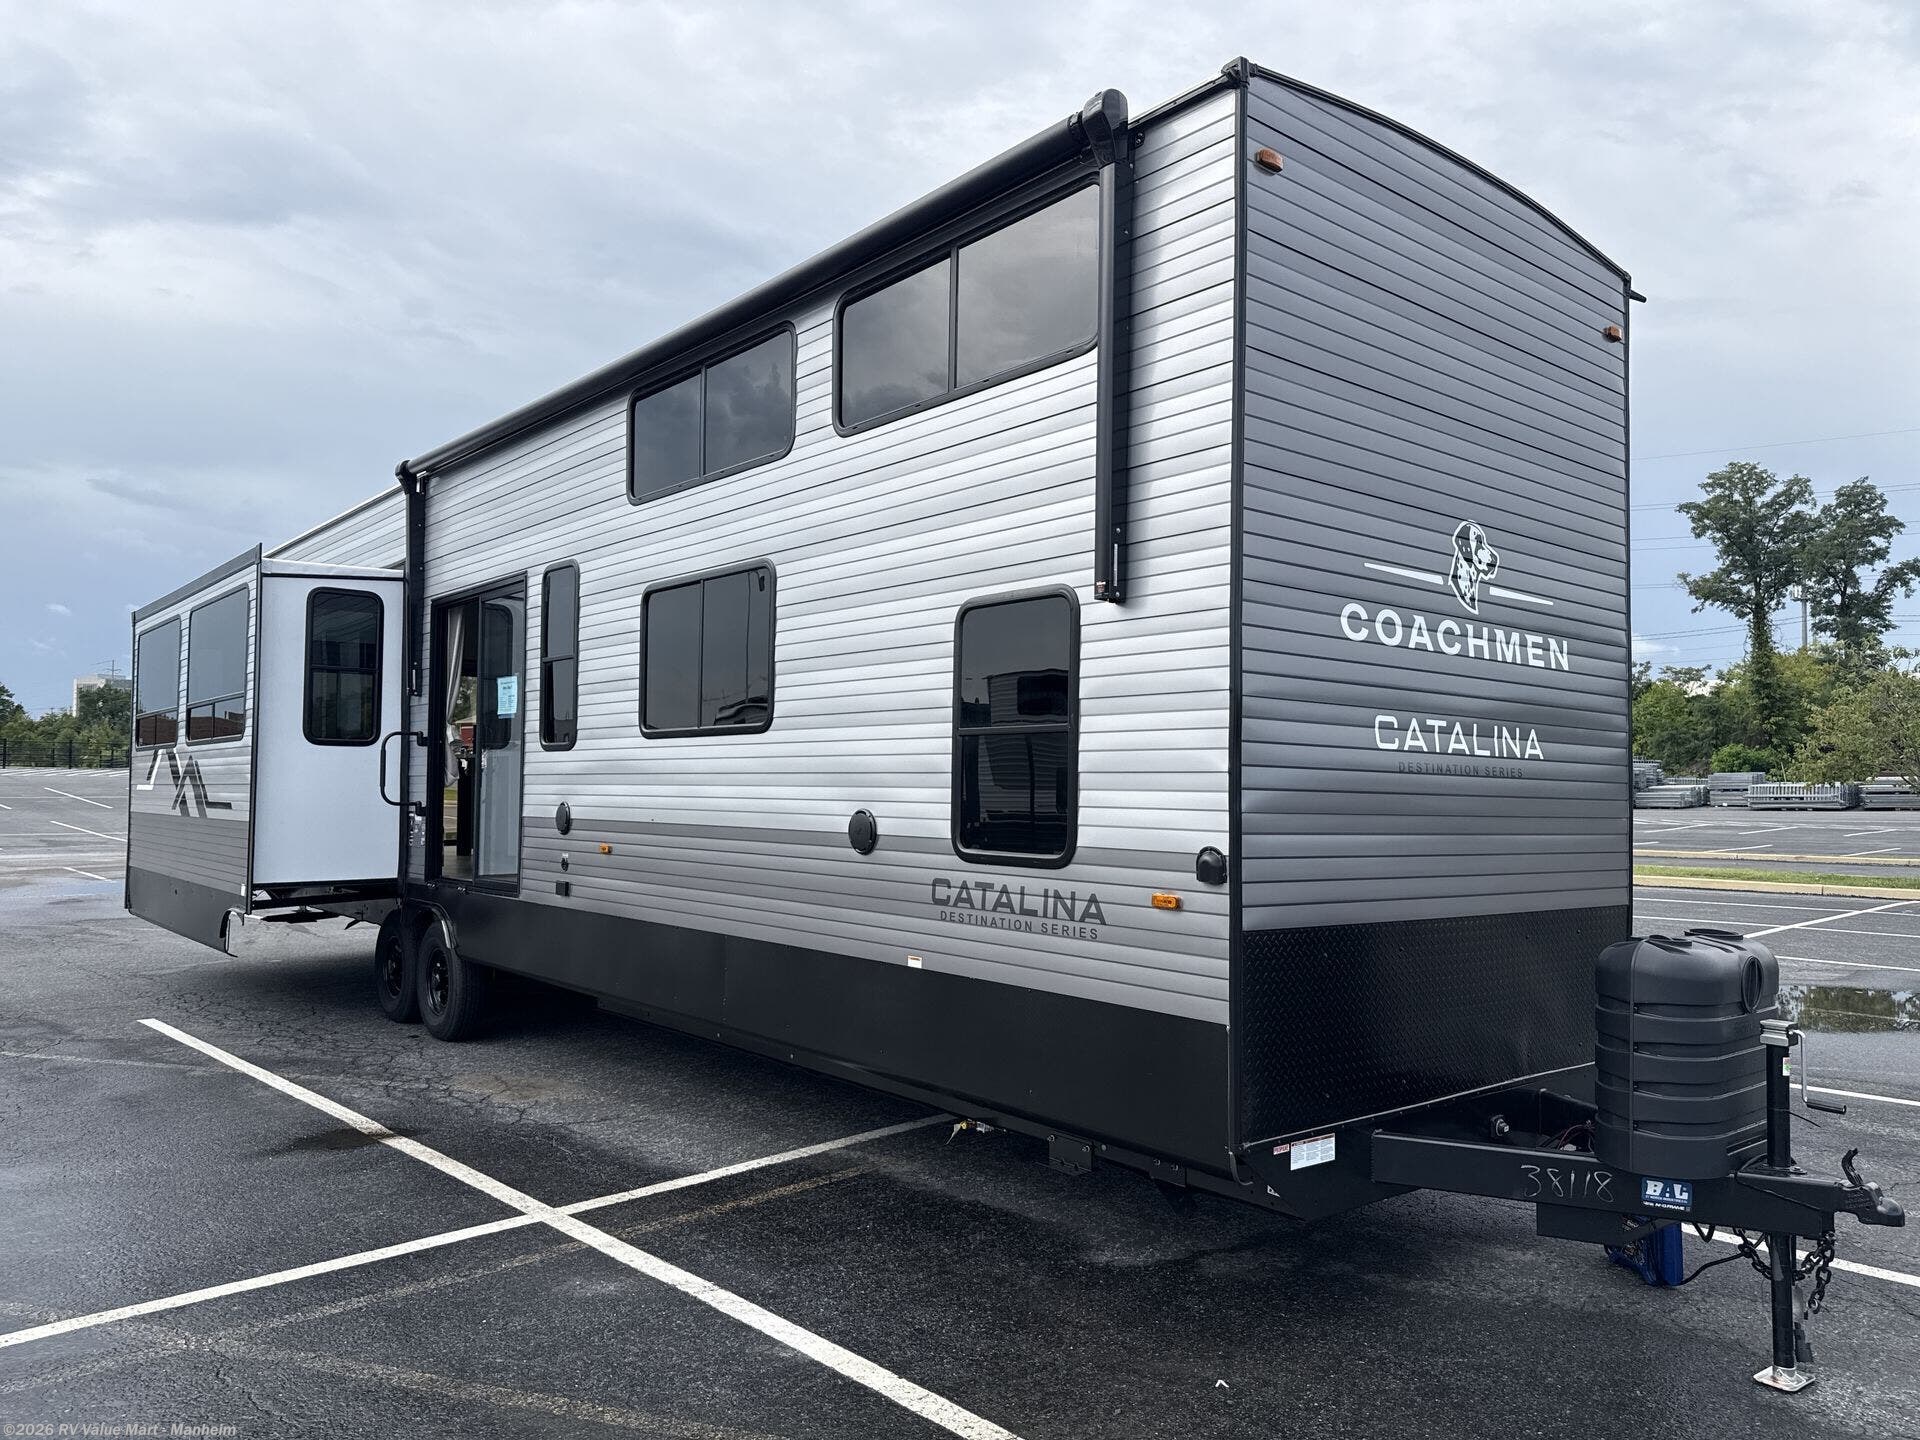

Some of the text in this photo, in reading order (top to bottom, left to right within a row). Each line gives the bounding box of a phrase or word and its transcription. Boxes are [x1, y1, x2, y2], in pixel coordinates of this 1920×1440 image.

[1340, 602, 1570, 671] COACHMEN
[1374, 714, 1544, 760] CATALINA
[1398, 761, 1524, 779] DESTINATION SERIES
[931, 877, 1107, 926] CATALINA
[940, 910, 1099, 940] DESTINATION SERIES
[1520, 1164, 1615, 1203] 38118
[1645, 1180, 1689, 1200] BAL
